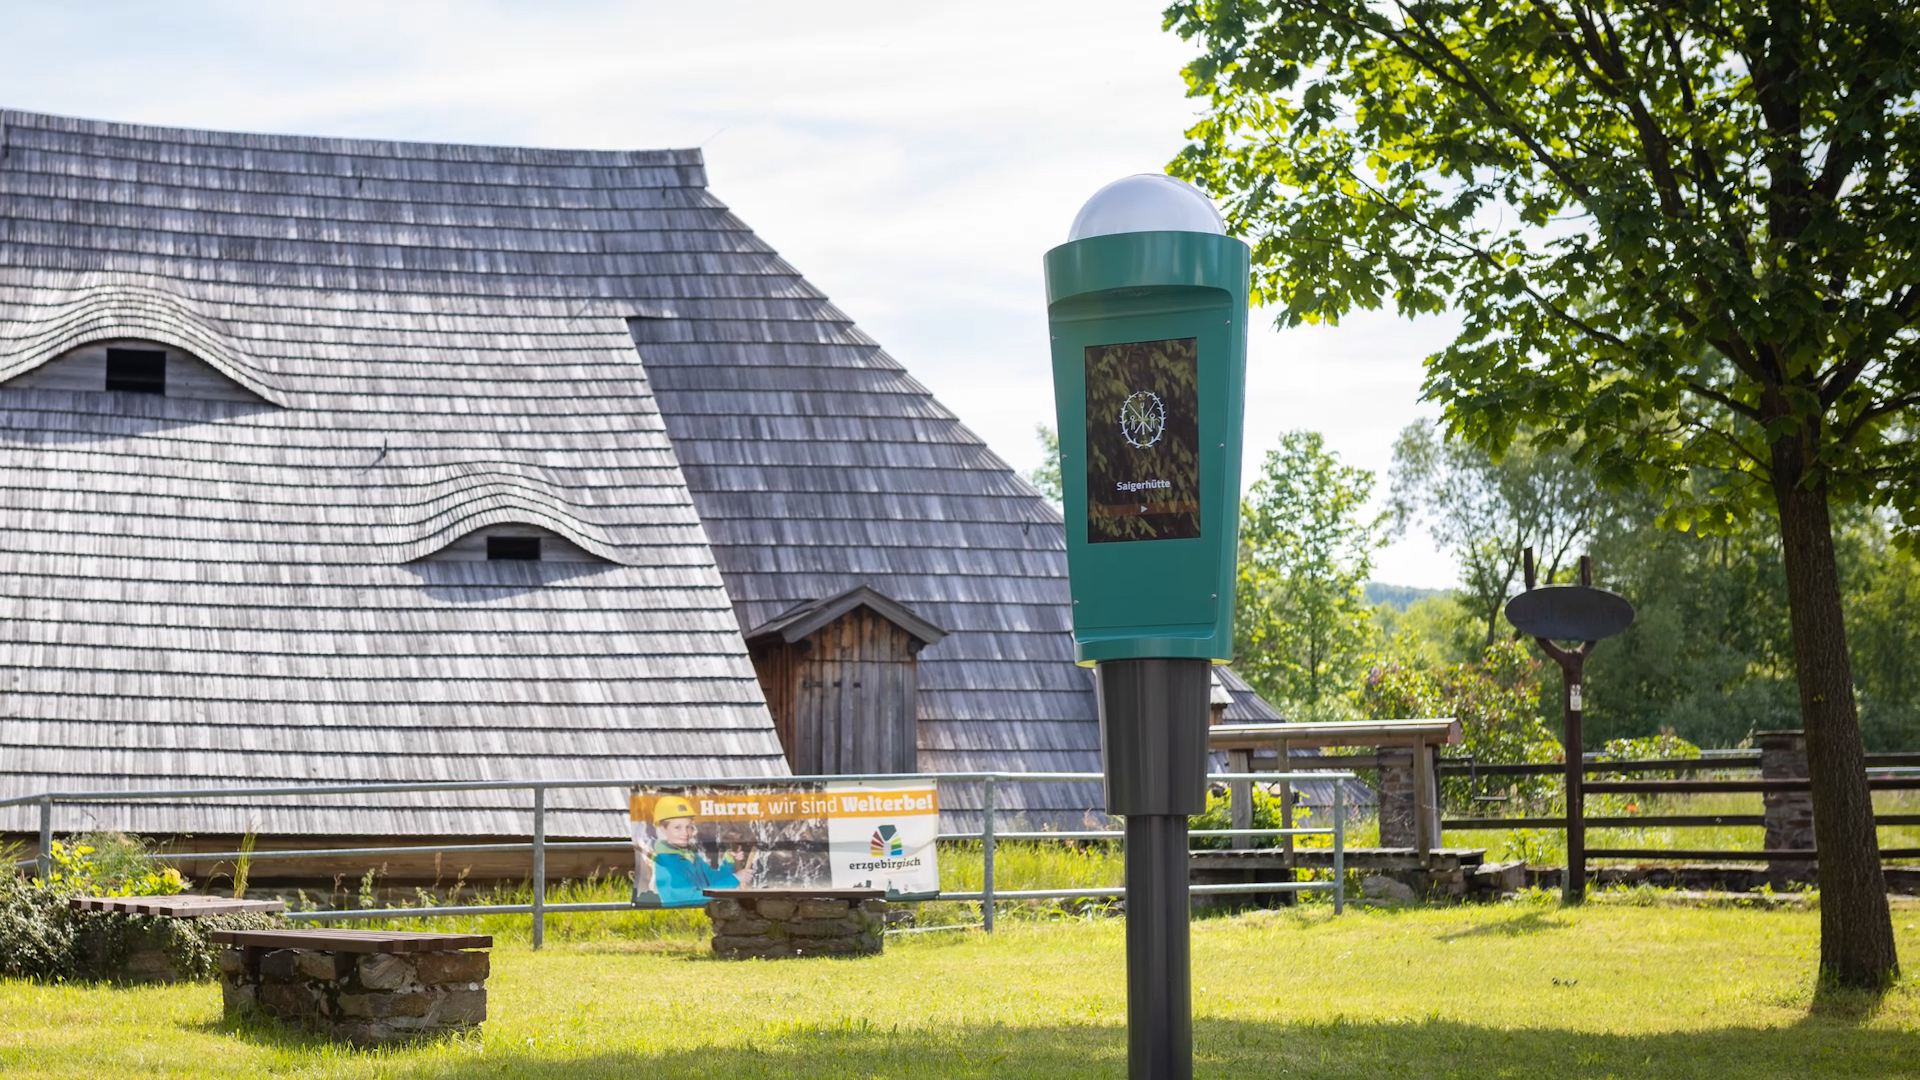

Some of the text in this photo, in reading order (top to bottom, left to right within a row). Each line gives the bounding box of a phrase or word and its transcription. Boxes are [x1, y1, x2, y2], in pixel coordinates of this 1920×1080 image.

[1116, 479, 1171, 492] Saigerhütte
[700, 794, 934, 818] Hurra, wir sind Welterbe!
[849, 857, 921, 871] erzgebirgisch
